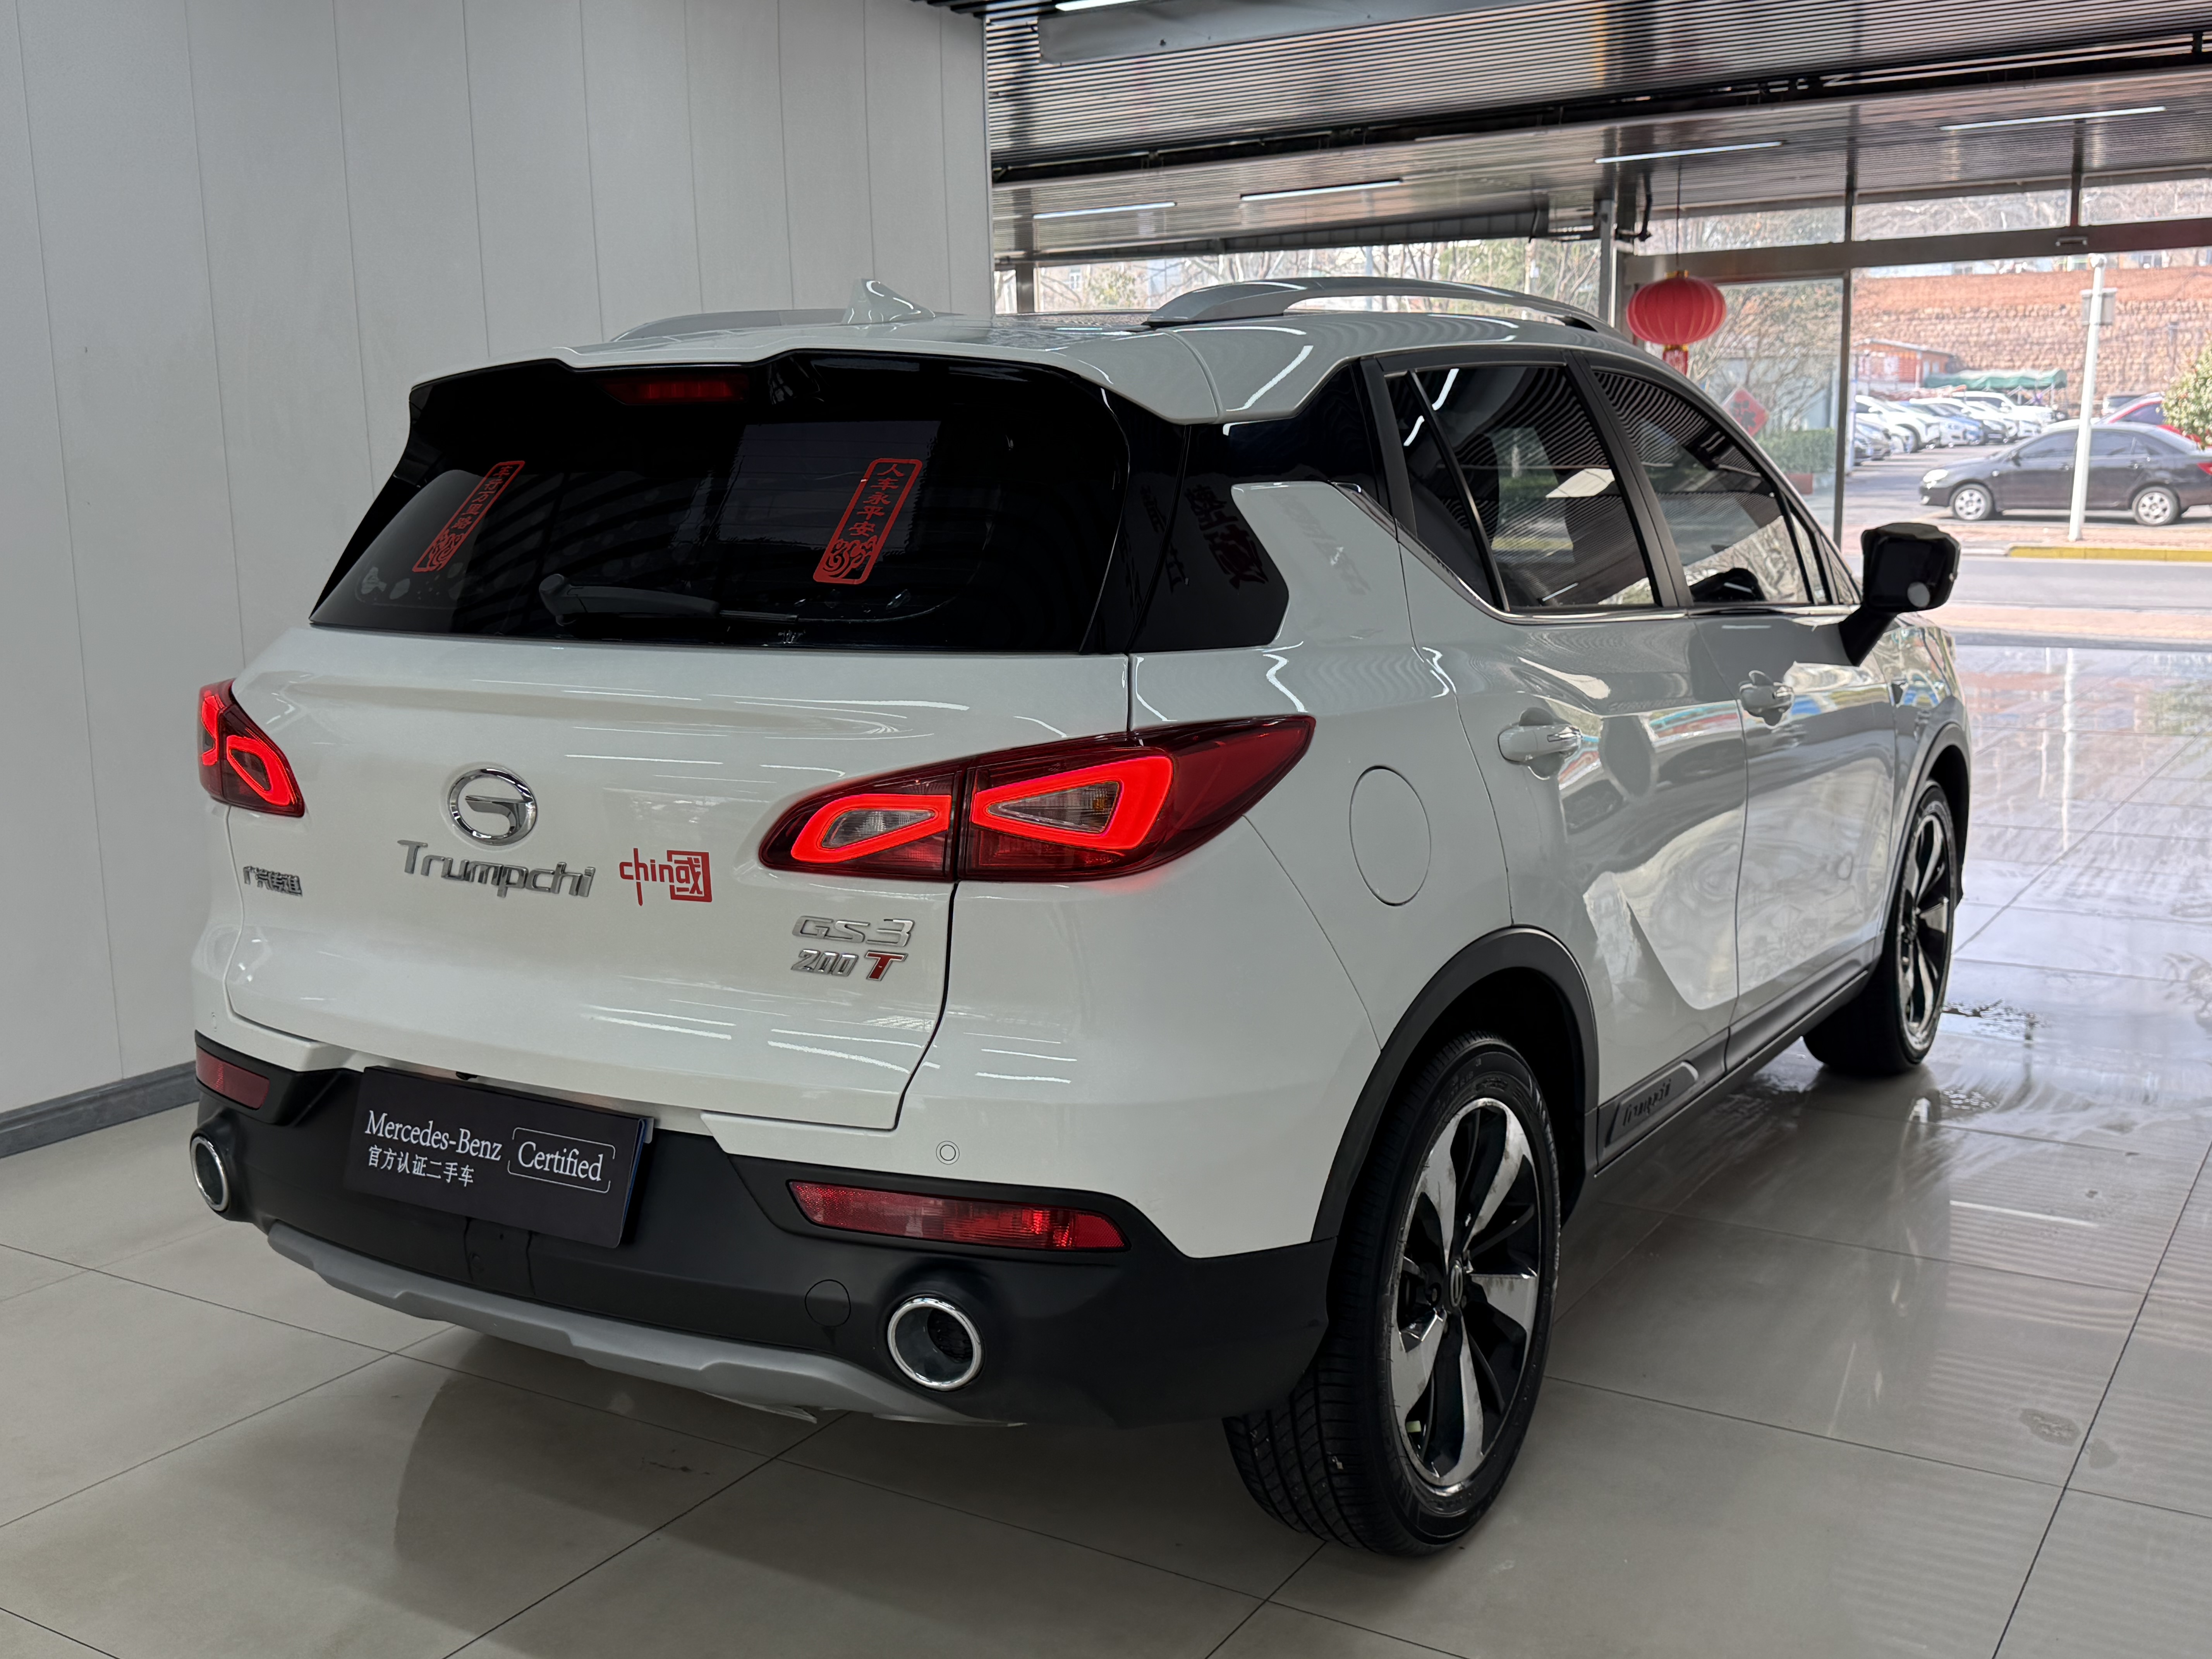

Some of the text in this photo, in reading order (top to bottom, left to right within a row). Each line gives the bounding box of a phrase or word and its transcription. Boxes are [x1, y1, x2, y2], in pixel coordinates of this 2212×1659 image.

[459, 466, 514, 529] 车行万里路
[848, 464, 905, 537] 人车永平安
[397, 839, 596, 898] Trumpchi
[792, 915, 915, 947] GS3
[365, 1110, 503, 1161] Mercedes-Benz
[518, 1140, 603, 1182] Certified
[368, 1144, 475, 1187] 官方认证二手车
